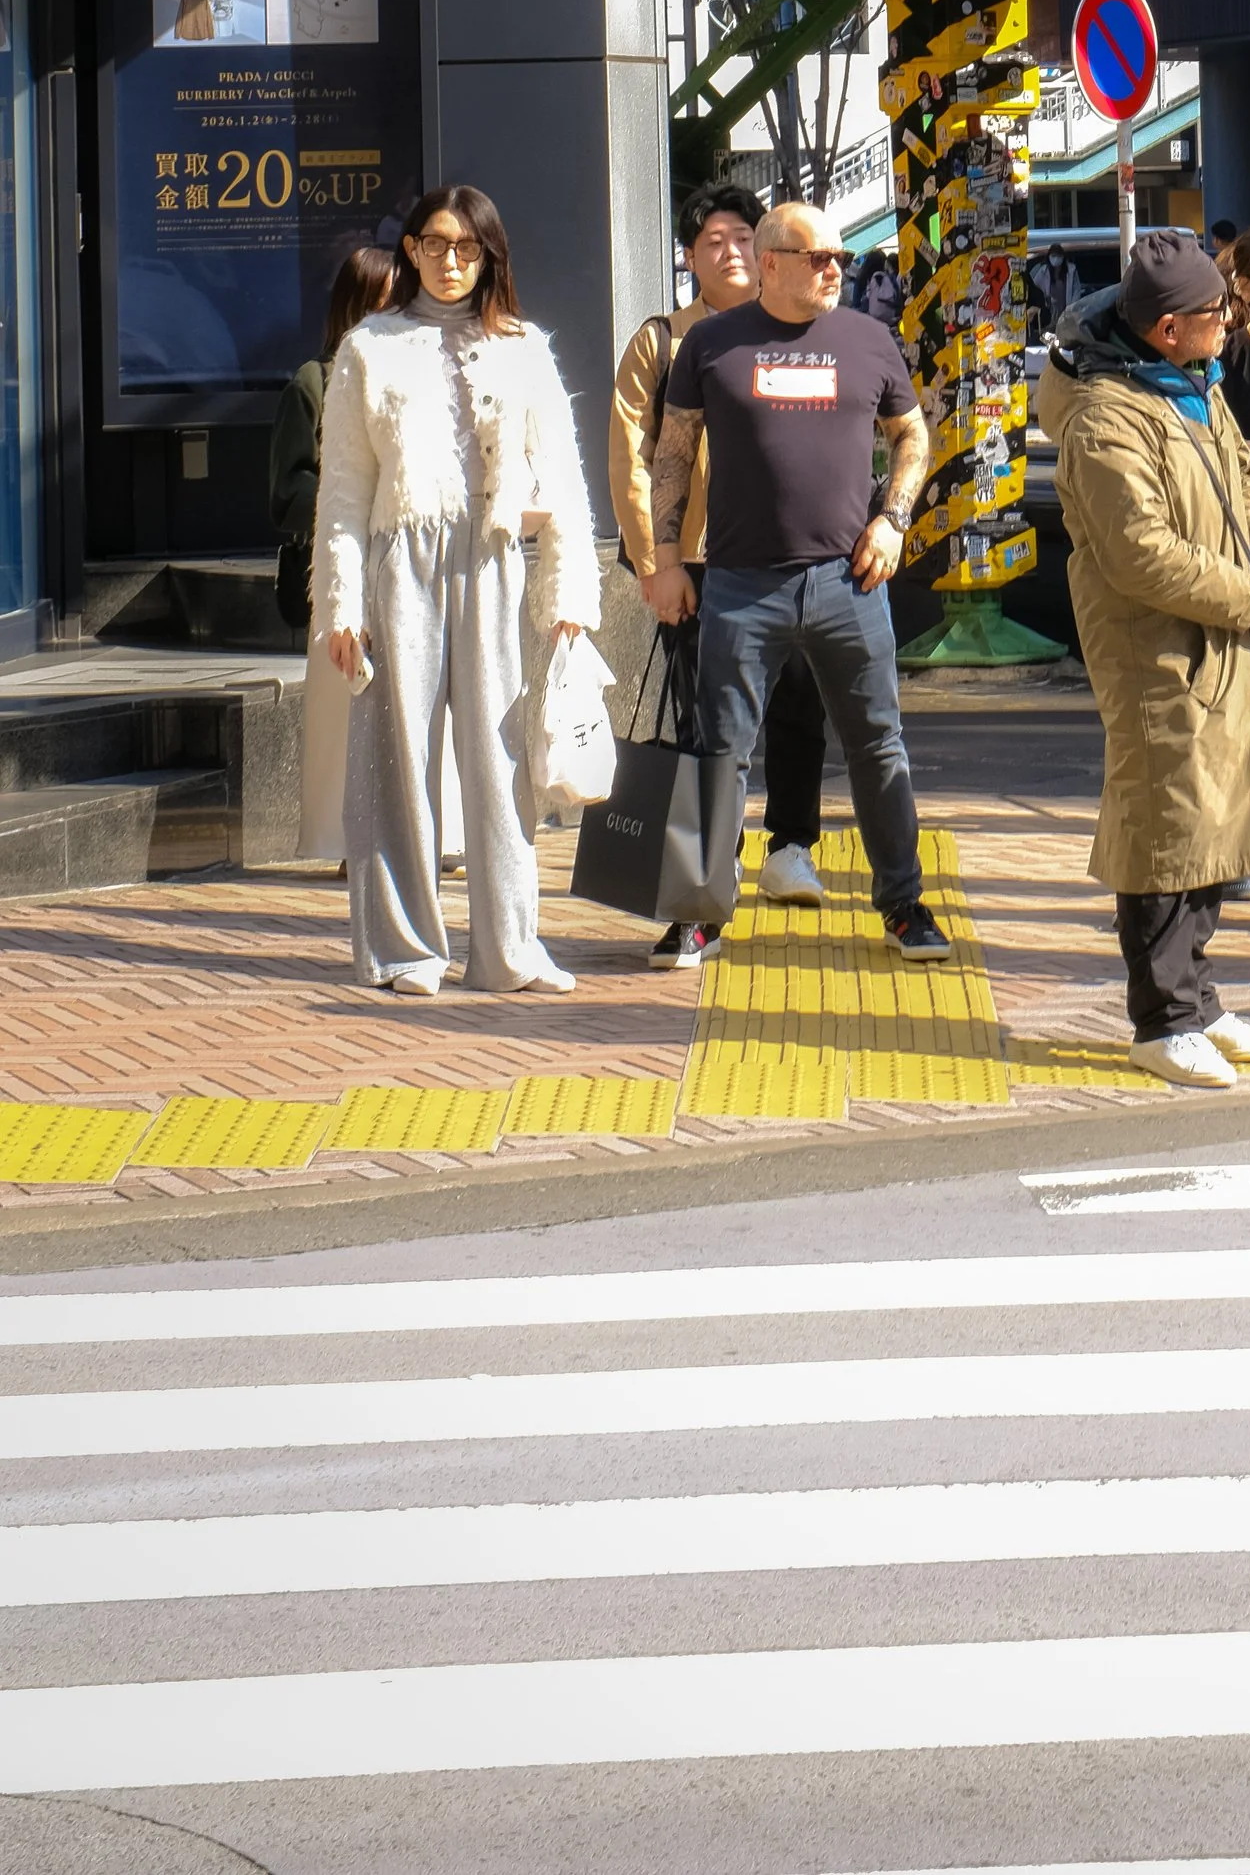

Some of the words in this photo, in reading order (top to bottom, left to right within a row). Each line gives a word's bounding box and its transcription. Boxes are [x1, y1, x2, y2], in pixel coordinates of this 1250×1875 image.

[218, 71, 262, 83] PRADA
[273, 70, 314, 82] GUCCI
[177, 89, 245, 101] BURBERRY
[155, 152, 209, 179] 買取
[155, 184, 210, 210] 金額
[754, 351, 837, 366] センチネル
[606, 812, 644, 838] GUCCI
